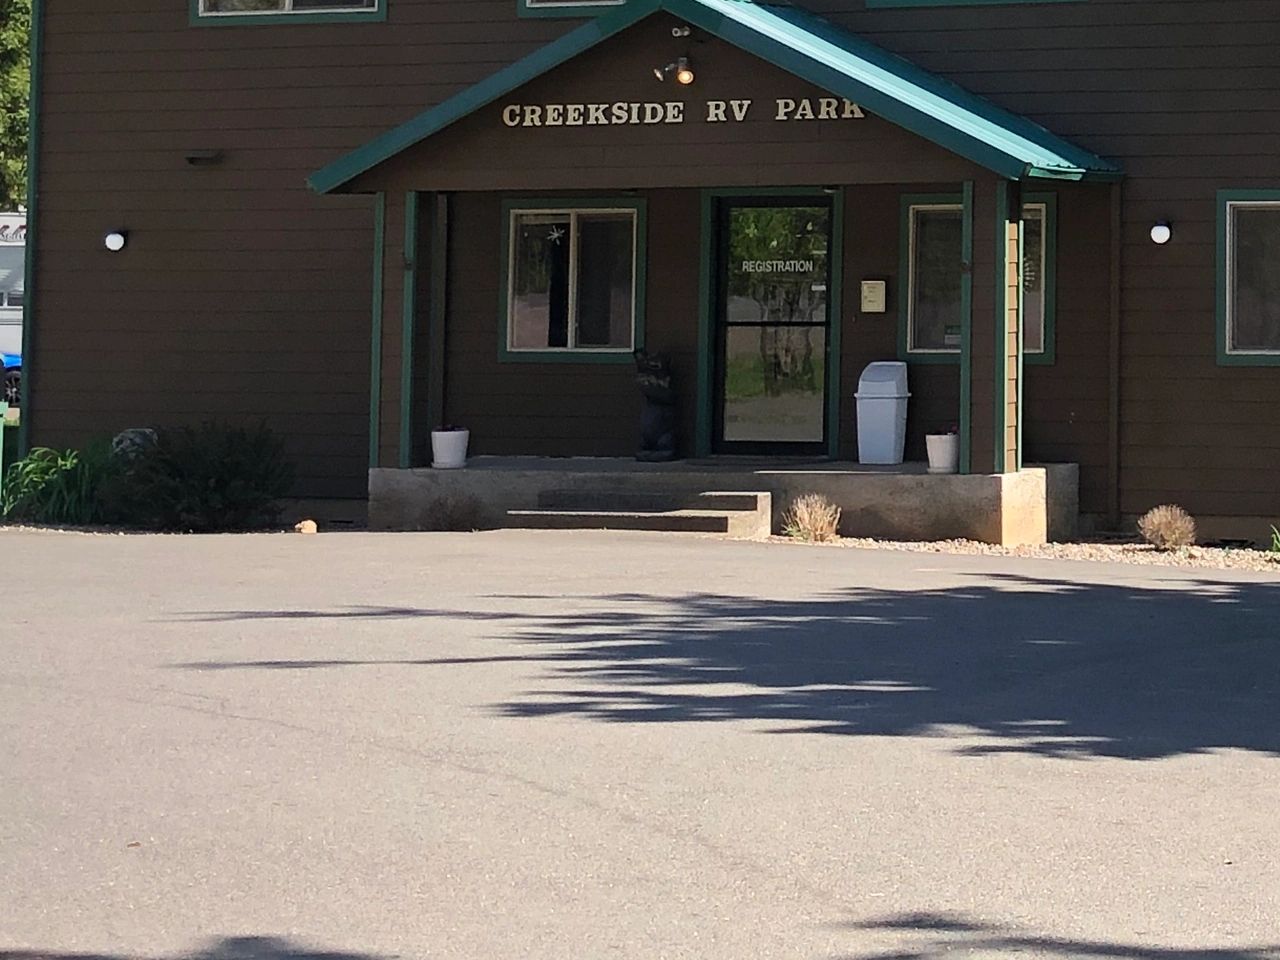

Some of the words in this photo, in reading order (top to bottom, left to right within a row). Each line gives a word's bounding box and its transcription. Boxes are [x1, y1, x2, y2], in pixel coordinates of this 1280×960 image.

[502, 102, 685, 127] CREEKSIDE
[706, 100, 751, 122] RV
[775, 98, 865, 120] PARK
[742, 260, 813, 273] REGISTRATION
